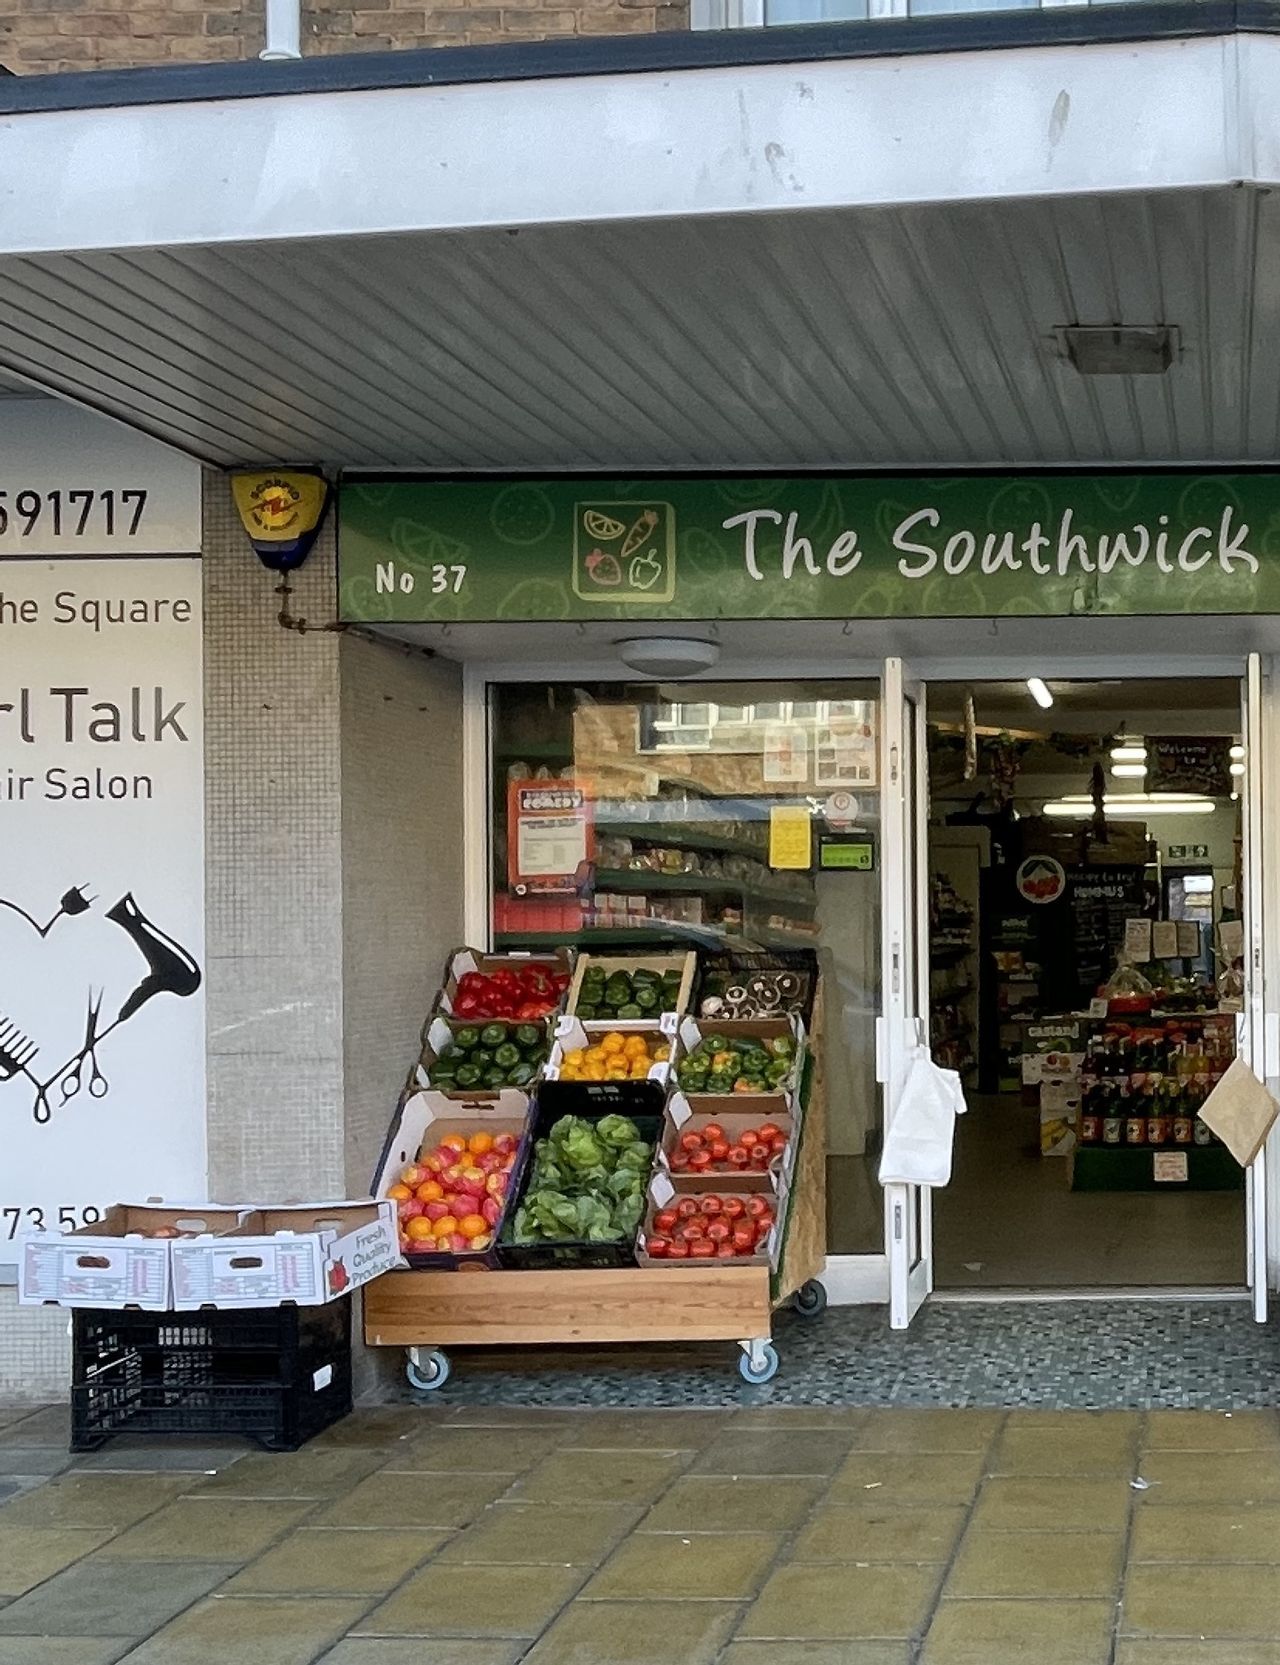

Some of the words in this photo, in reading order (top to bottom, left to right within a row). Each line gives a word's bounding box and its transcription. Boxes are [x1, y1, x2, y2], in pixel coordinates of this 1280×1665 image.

[722, 508, 863, 581] The
[892, 505, 1260, 579] Southwick
[376, 561, 415, 594] No
[431, 564, 467, 593] 37
[53, 591, 192, 632] Square
[49, 686, 189, 743] Talk
[44, 767, 153, 801] Salon
[3, 1207, 47, 1240] 73
[356, 1225, 387, 1250] Fresh
[352, 1256, 396, 1286] Produce
[353, 1241, 392, 1268] Quality
